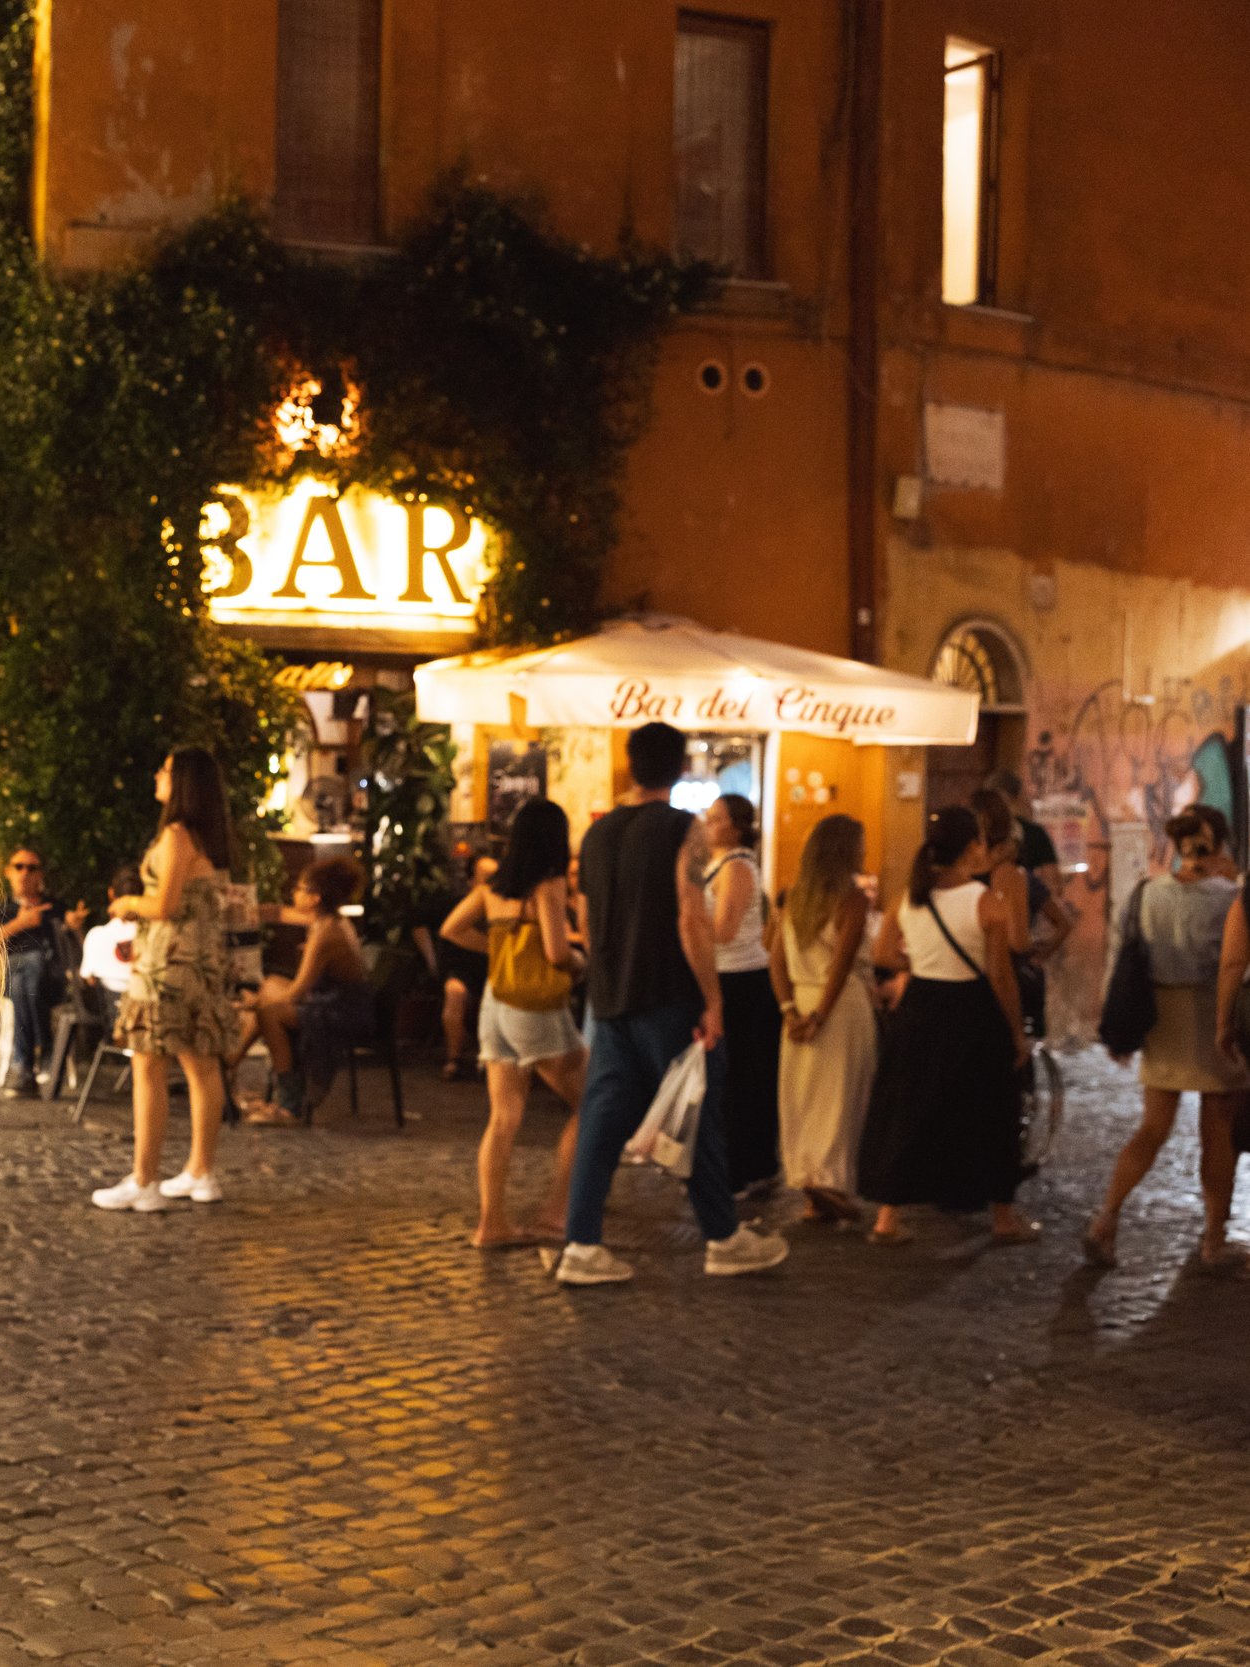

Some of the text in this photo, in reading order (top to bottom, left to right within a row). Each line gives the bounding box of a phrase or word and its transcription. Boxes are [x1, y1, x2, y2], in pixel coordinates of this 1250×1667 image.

[199, 496, 475, 604] BAR
[610, 676, 896, 732] Bar del Cinque
